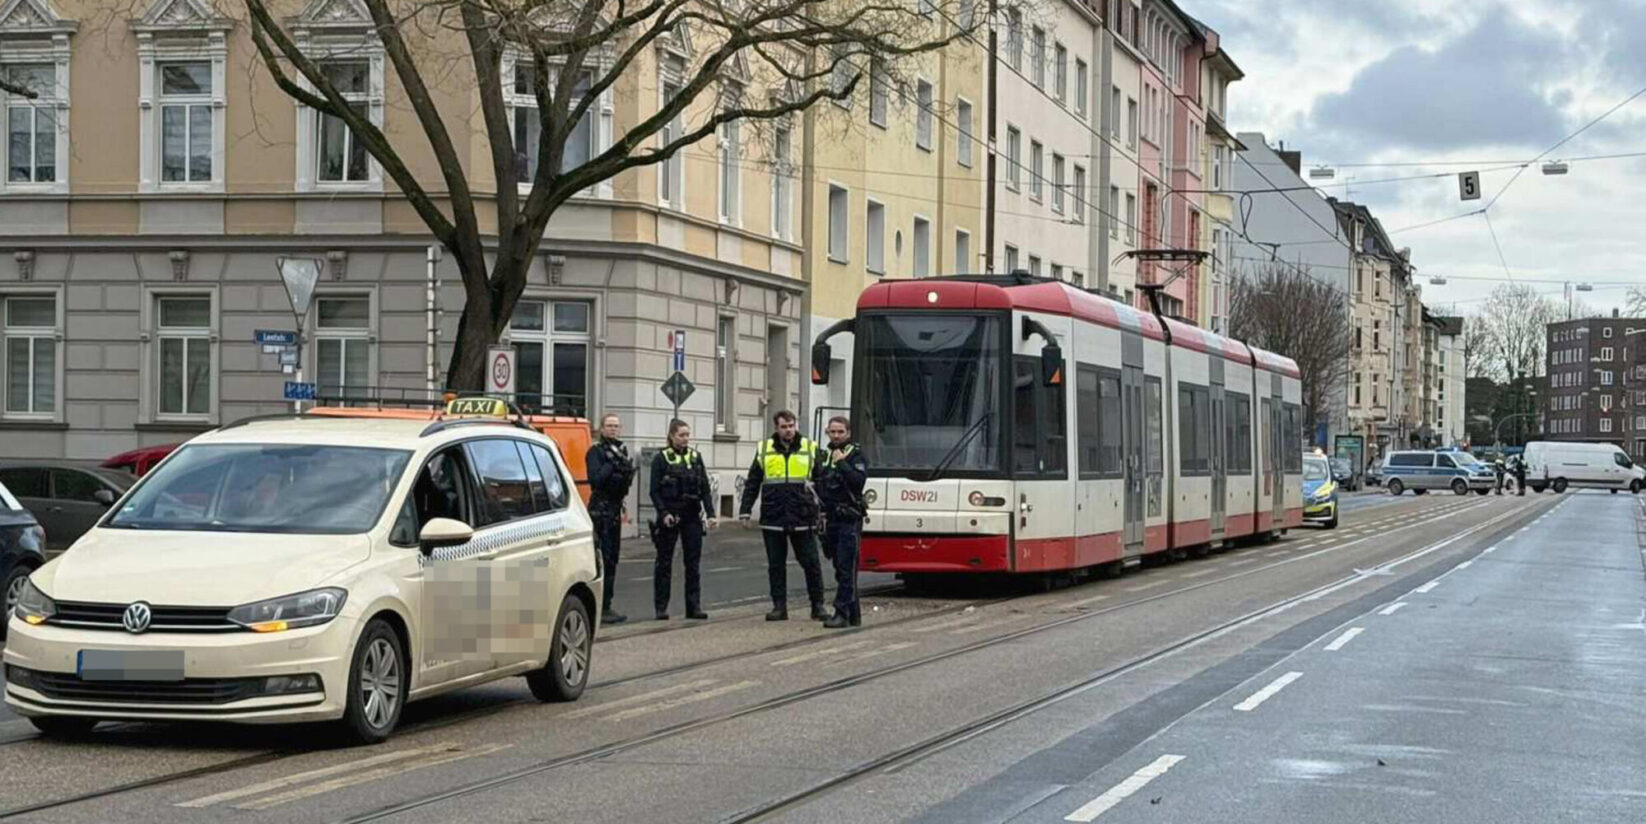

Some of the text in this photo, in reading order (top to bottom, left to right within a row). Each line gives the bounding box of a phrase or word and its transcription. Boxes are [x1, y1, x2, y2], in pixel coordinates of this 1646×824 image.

[1464, 176, 1475, 195] 5
[496, 362, 507, 379] 30
[456, 401, 492, 413] TAXI
[916, 518, 924, 528] 3
